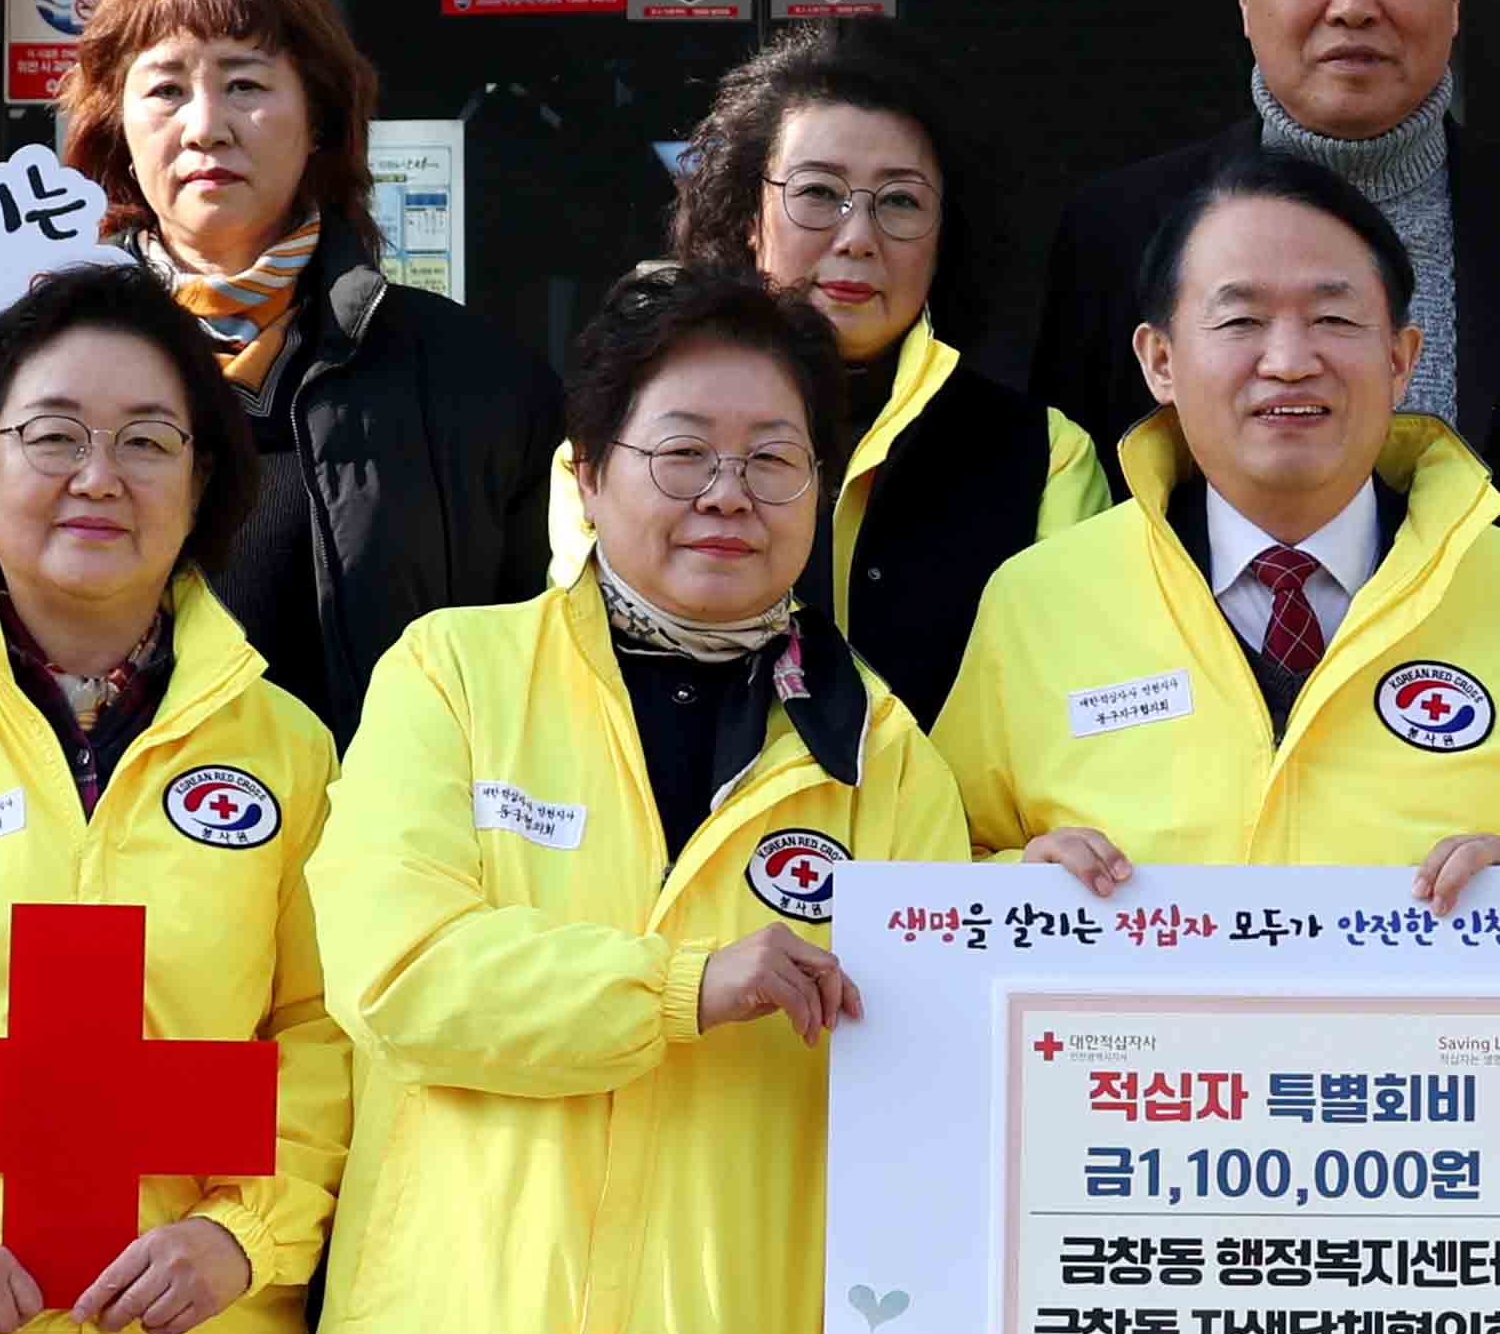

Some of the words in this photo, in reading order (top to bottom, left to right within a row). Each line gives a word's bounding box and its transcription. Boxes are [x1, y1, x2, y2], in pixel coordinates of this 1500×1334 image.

[1389, 668, 1431, 691] KOREAN
[1431, 670, 1454, 681] RED
[214, 771, 236, 782] RED
[757, 836, 797, 859] KOREAN
[797, 836, 819, 848] RED
[887, 902, 994, 950] 생명을
[1004, 903, 1103, 948] 살리는
[1114, 904, 1218, 948] 적십자
[1228, 910, 1323, 945] 모두가
[1337, 906, 1439, 947] 안전한
[1069, 1034, 1157, 1052] 대한적십자사
[1439, 1036, 1491, 1053] Saving
[1089, 1070, 1249, 1122] 적십자
[1266, 1071, 1477, 1124] 특별회비
[1084, 1146, 1481, 1207] 금1,100,000원
[1059, 1236, 1206, 1287] 금창동
